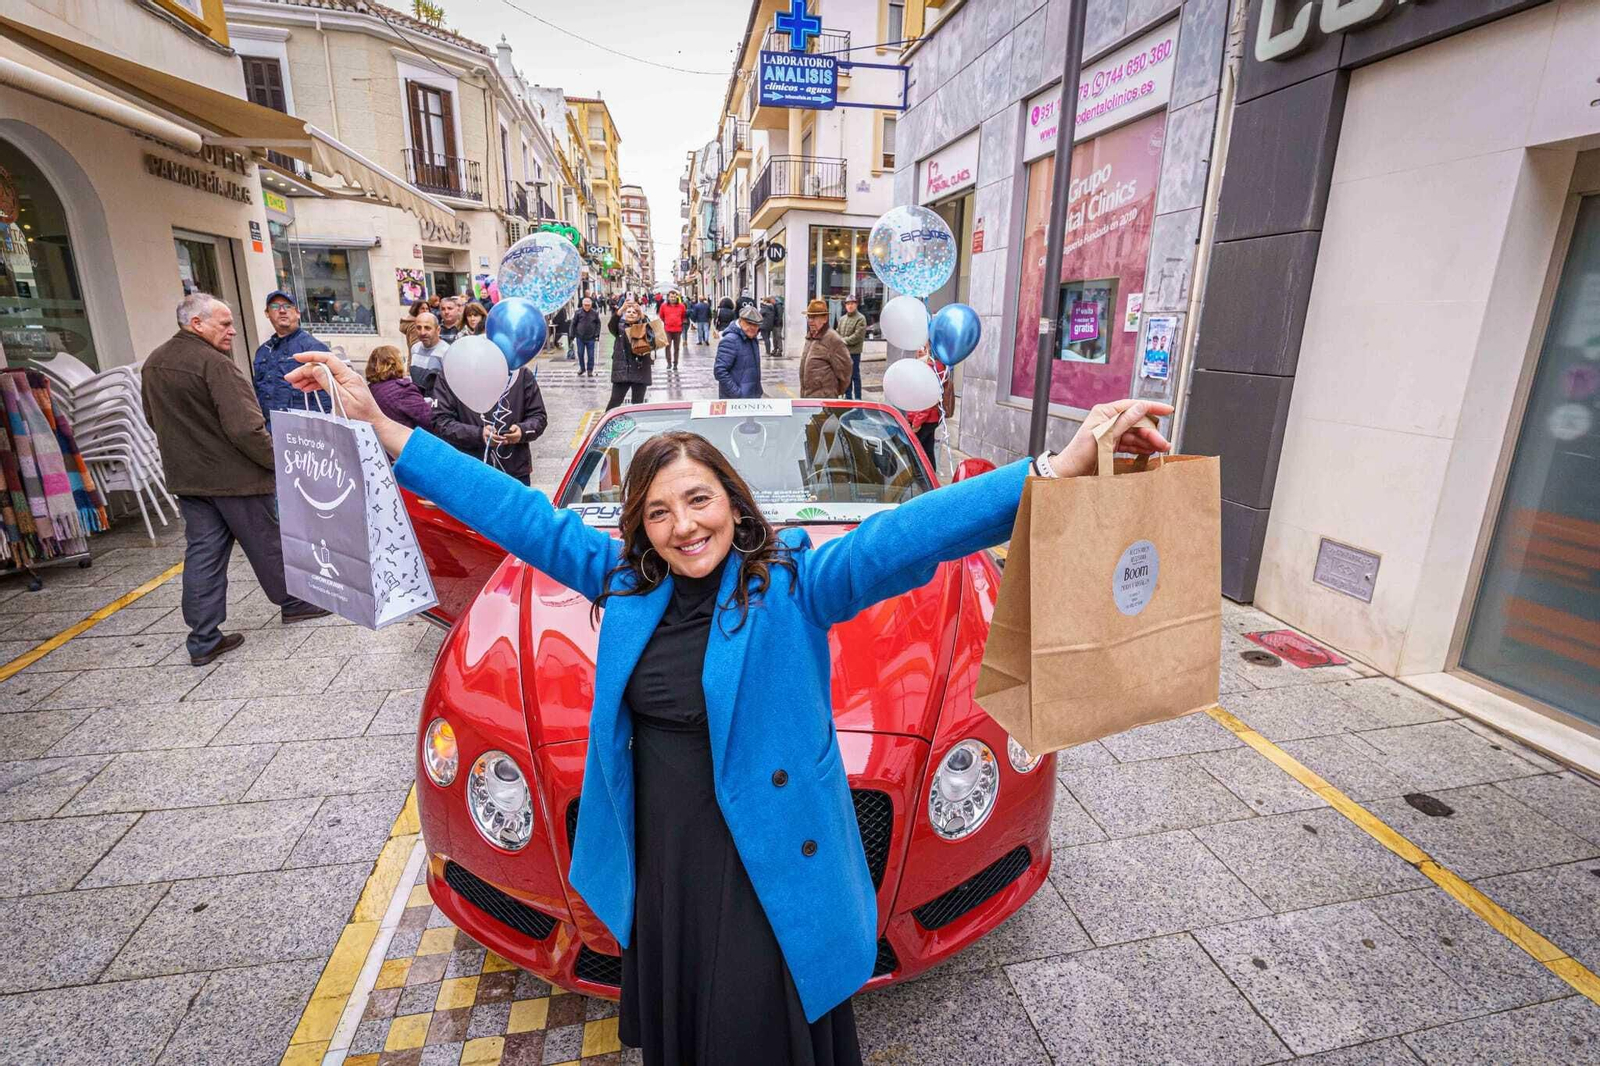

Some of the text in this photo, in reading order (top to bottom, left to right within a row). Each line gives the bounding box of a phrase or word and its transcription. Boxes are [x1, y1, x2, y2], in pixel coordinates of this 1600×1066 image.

[763, 54, 834, 69] LABORATORIO
[764, 65, 833, 85] ANALISIS
[764, 82, 798, 92] clínicos
[806, 86, 832, 95] aguas
[1040, 102, 1054, 120] 951
[1106, 65, 1123, 87] 744
[1126, 52, 1147, 77] 650
[1069, 163, 1112, 203] Grupo
[1087, 179, 1137, 221] Clinics
[1119, 206, 1138, 226] 2010
[770, 248, 782, 258] IN
[1074, 323, 1094, 335] gratis
[286, 433, 325, 450] Es hora de
[284, 448, 346, 488] sonreír
